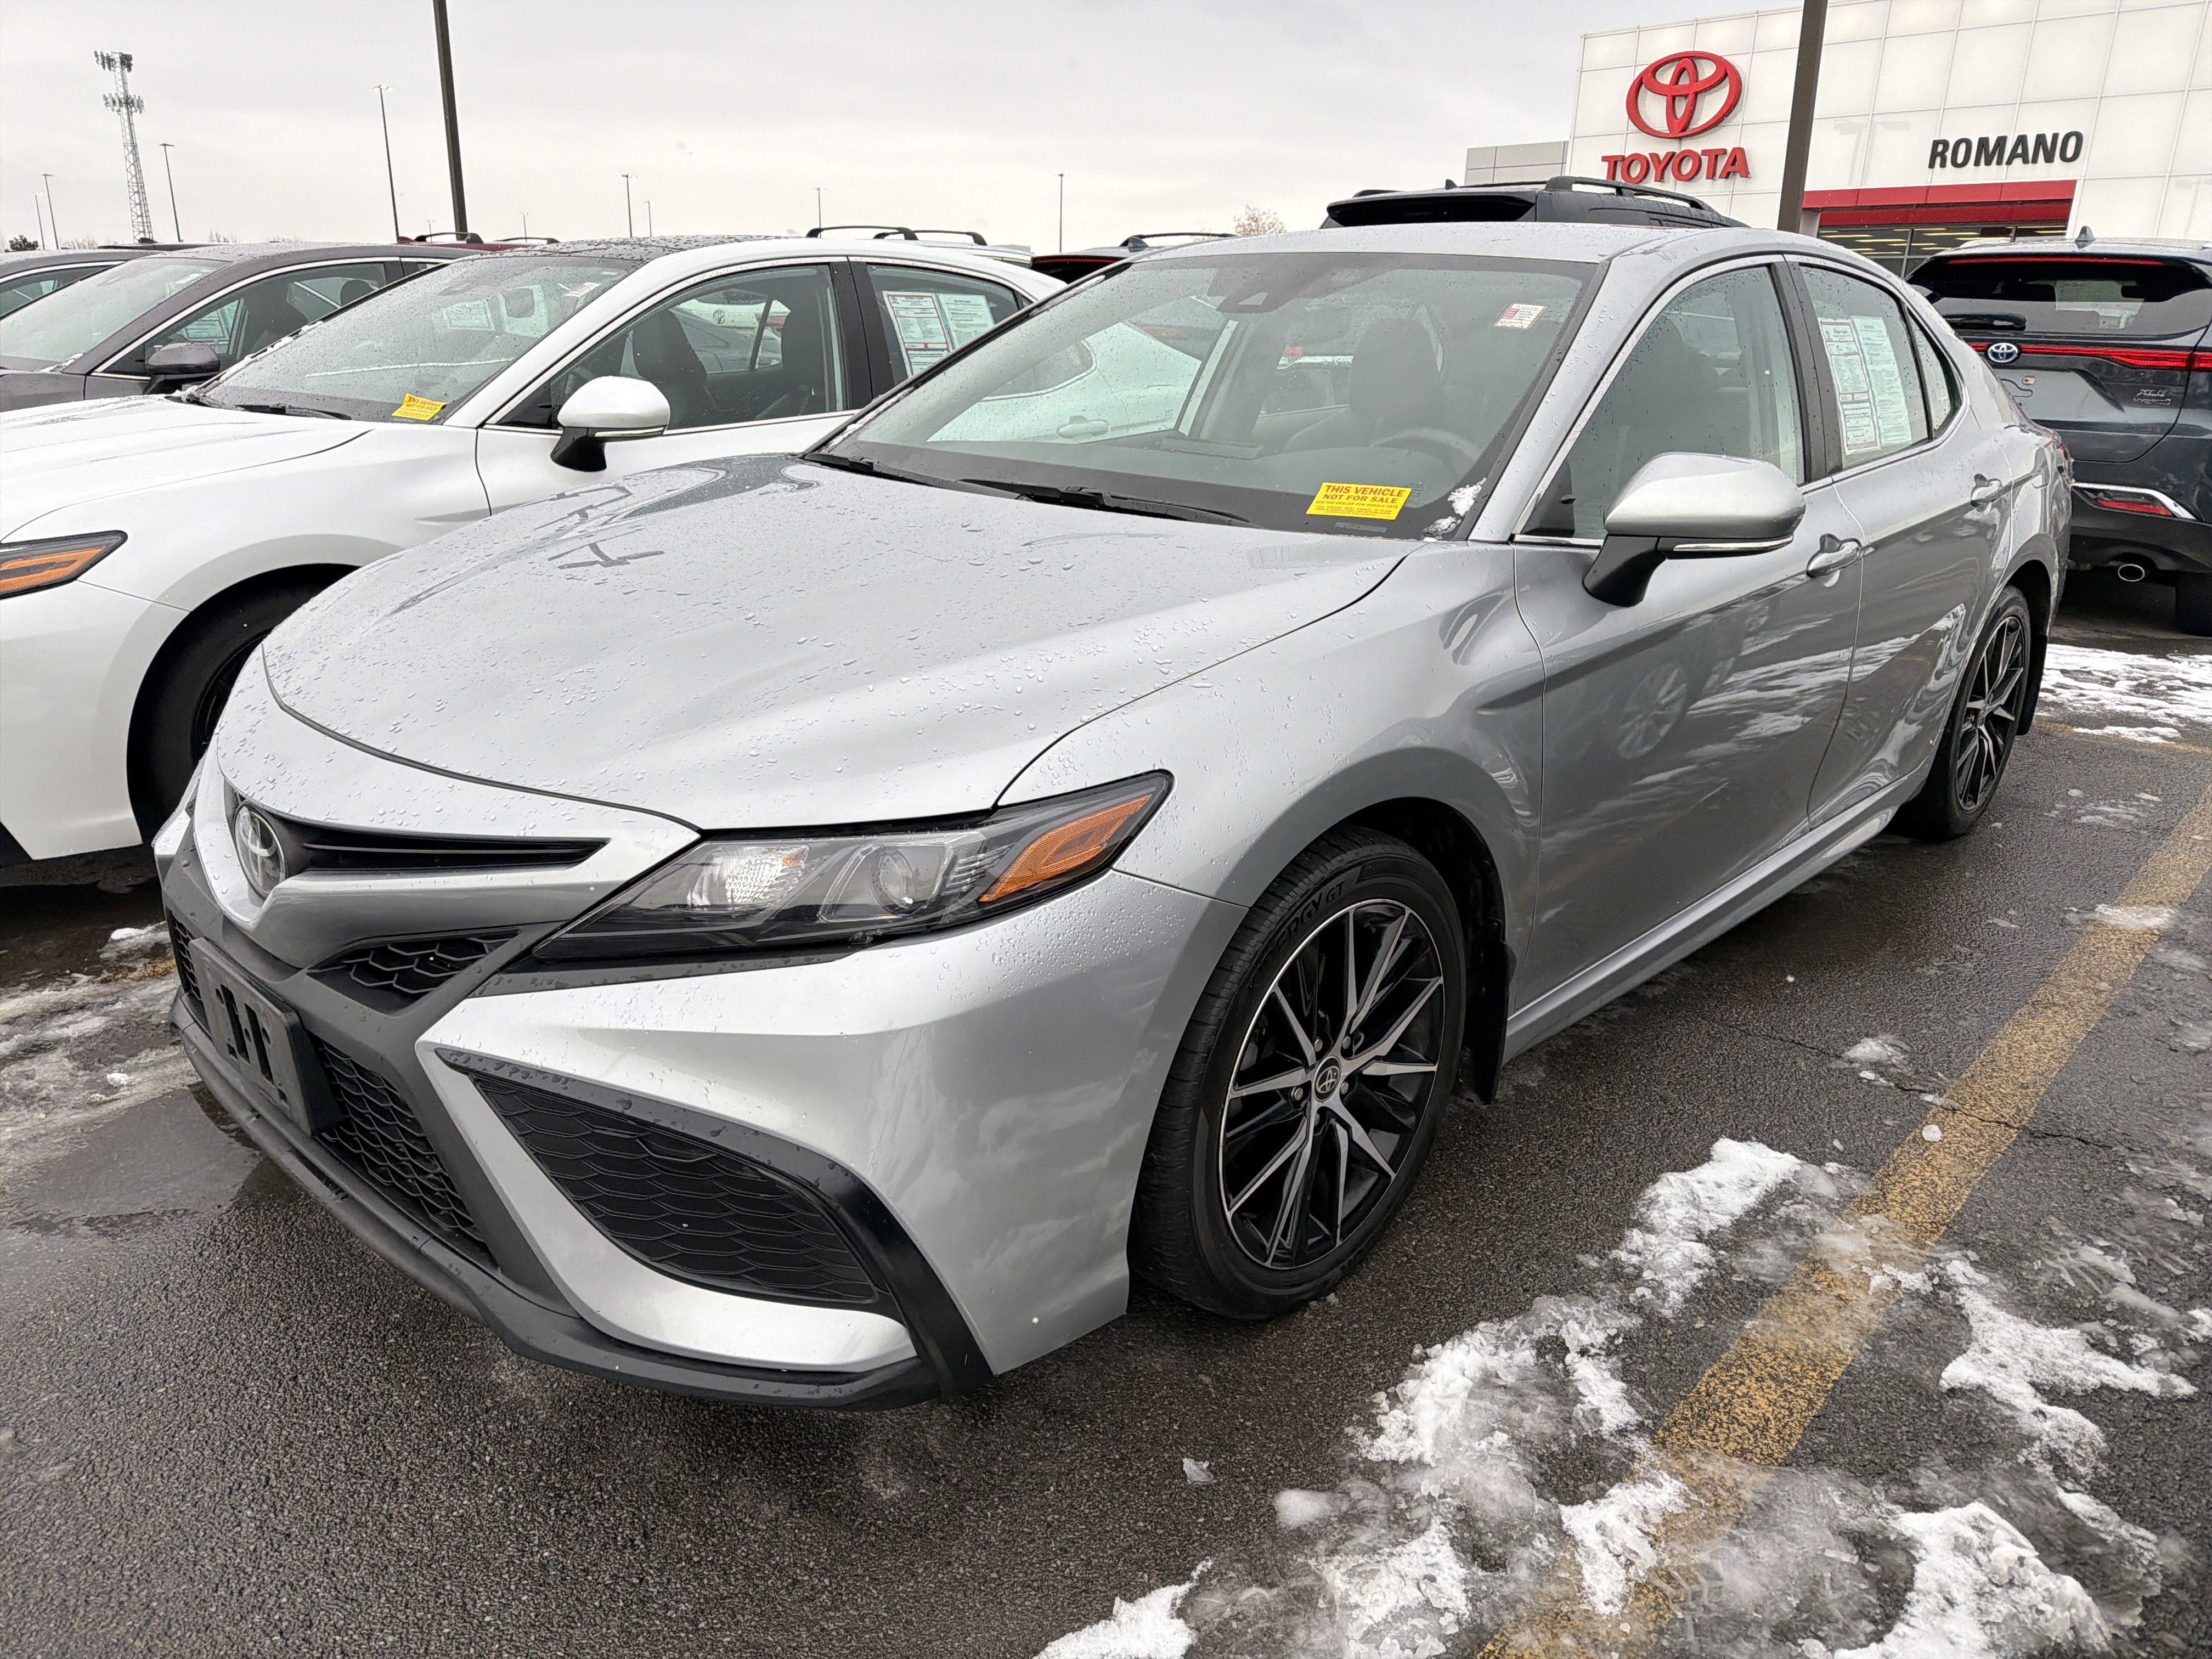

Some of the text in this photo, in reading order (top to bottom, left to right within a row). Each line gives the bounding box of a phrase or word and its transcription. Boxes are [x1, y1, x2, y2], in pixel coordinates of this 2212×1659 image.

[1928, 131, 2084, 168] ROMANO
[1601, 147, 1751, 184] TOYOTA
[1325, 485, 1352, 494] THIS
[1355, 487, 1406, 497] VEHICLE
[1326, 881, 1345, 904] GT
